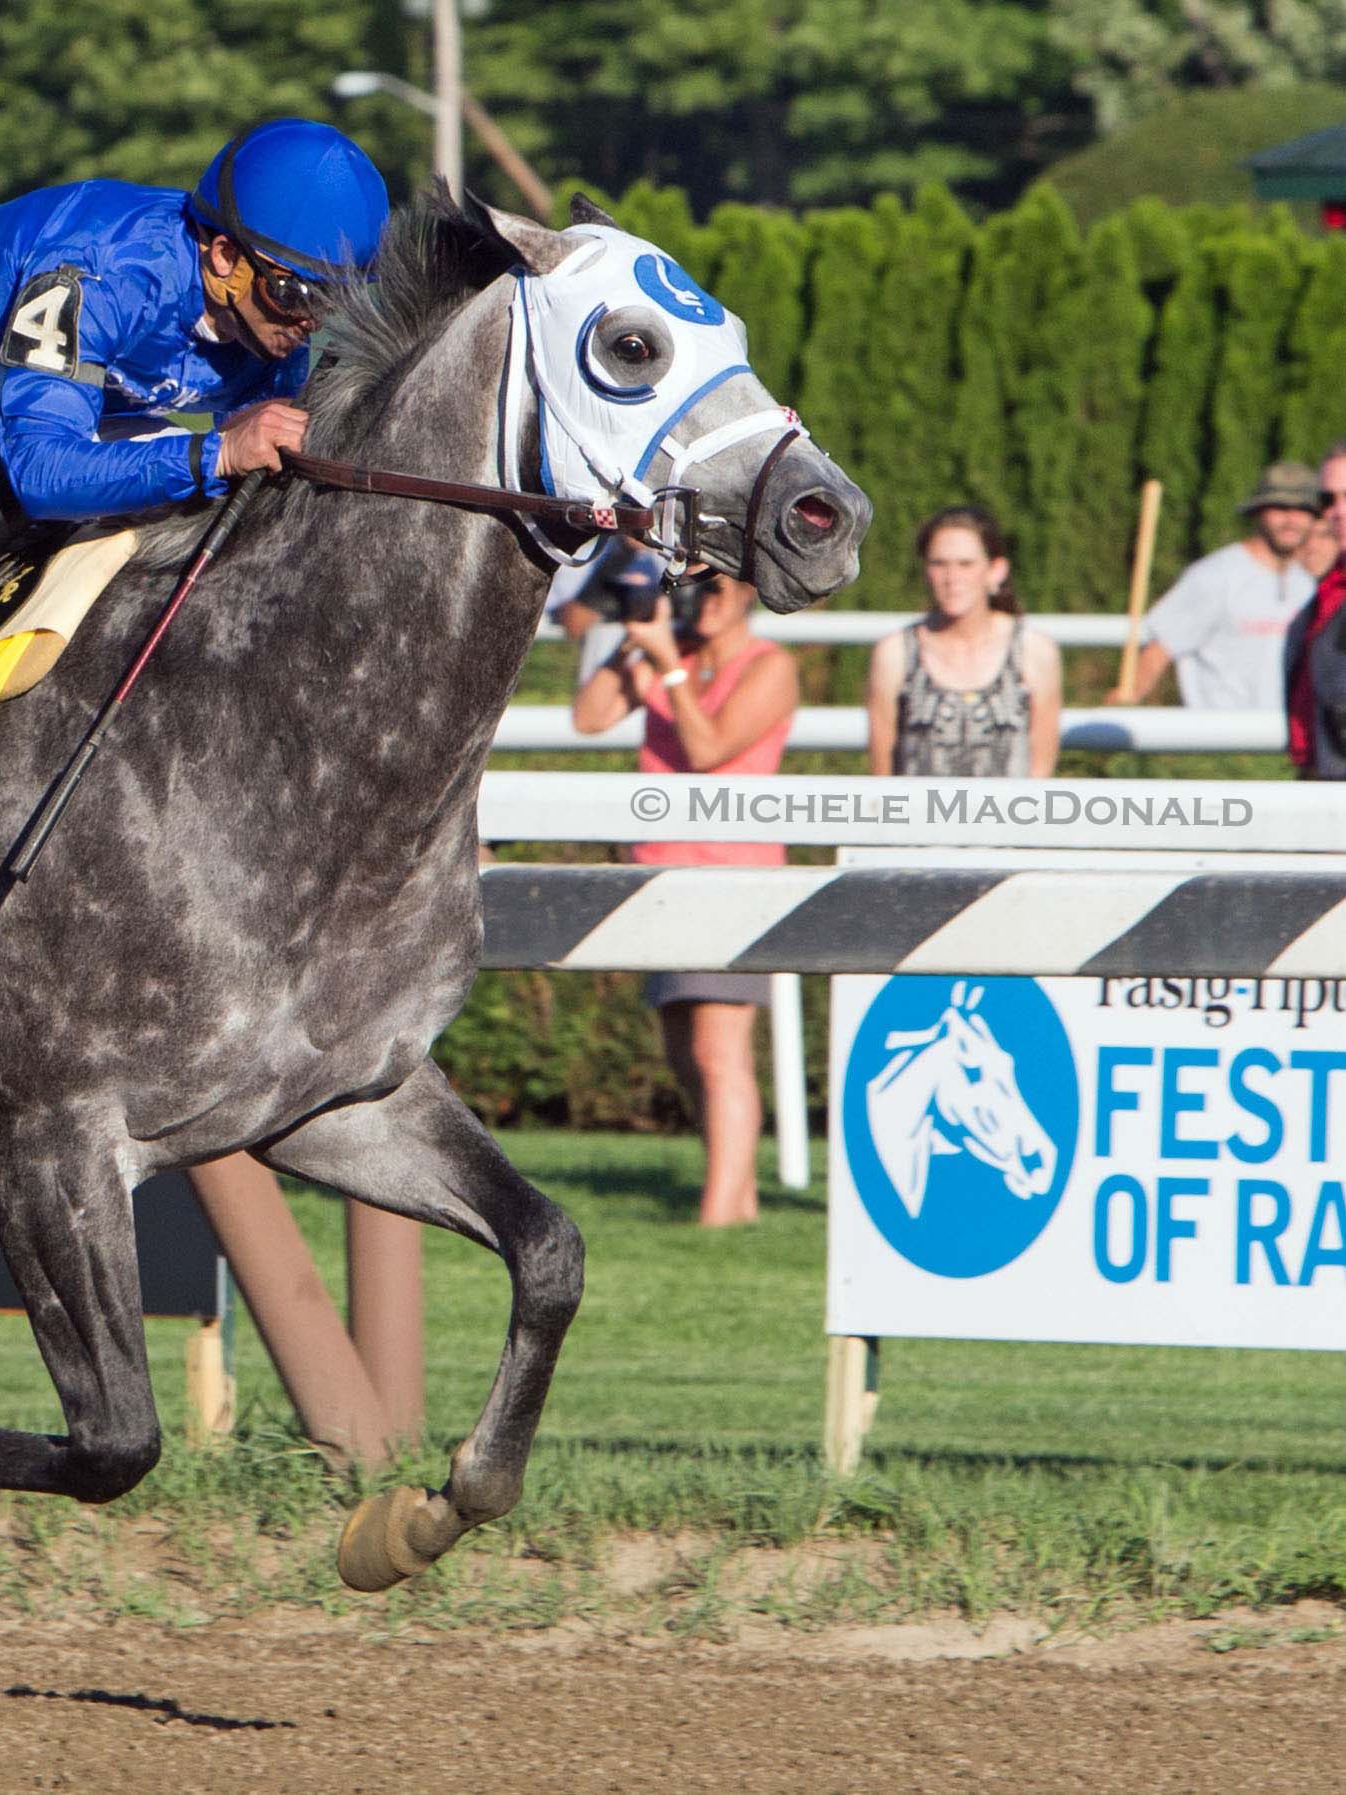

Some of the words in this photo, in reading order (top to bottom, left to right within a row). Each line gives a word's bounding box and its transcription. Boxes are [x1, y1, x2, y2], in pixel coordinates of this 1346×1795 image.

[12, 286, 70, 371] 4
[1095, 1046, 1346, 1164] FEST
[1093, 1174, 1210, 1284] OF
